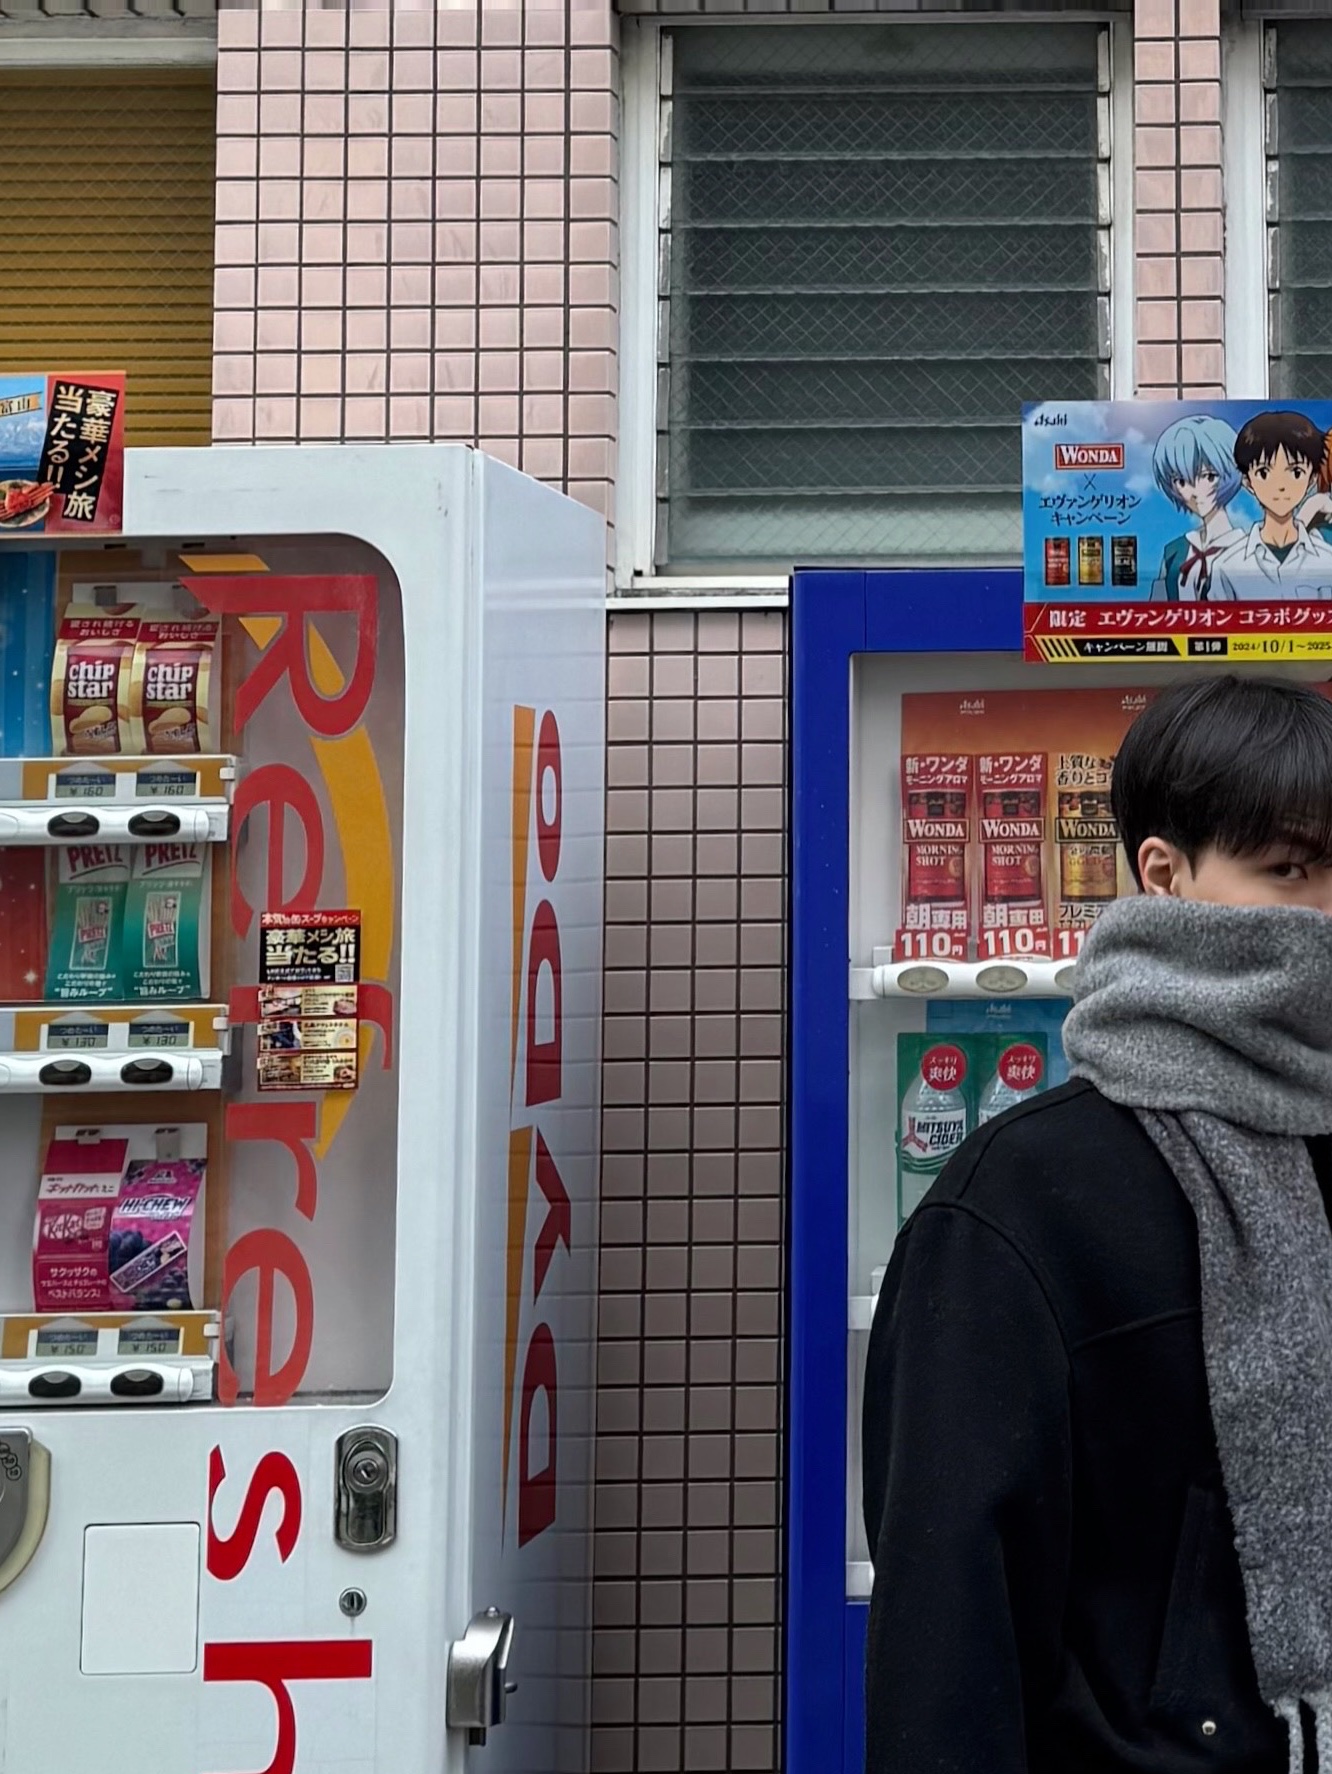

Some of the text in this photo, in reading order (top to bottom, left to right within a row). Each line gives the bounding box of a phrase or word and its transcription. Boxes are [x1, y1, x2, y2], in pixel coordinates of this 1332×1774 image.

[1033, 413, 1068, 427] Asahi
[64, 389, 118, 520] 豪華メシ旅
[1059, 445, 1119, 464] WONDA
[1038, 493, 1142, 510] エヴァンゲリオン
[1050, 511, 1131, 527] キャンペーン
[1049, 609, 1087, 628] 限定
[1097, 608, 1233, 627] エヴァンゲリオン
[69, 661, 115, 680] chip
[147, 663, 194, 682] chip
[67, 679, 114, 699] star
[146, 681, 192, 701] star
[905, 774, 968, 785] モーニングアロマ
[979, 774, 1043, 785] モーニングアロマ
[907, 819, 966, 839] WONDA
[981, 819, 1040, 839] WONDA
[1060, 818, 1117, 838] WONDA
[915, 855, 946, 867] SHOT
[991, 855, 1022, 867] SHOT
[905, 902, 968, 930] 朝専用
[982, 901, 1045, 929] 朝専用
[265, 927, 357, 945] 豪華メシ旅
[900, 931, 963, 958] 110円
[983, 927, 1047, 960] 110円
[928, 1065, 957, 1082] 爽快
[1006, 1064, 1036, 1081] 爽快
[916, 1119, 964, 1134] MITSUYA
[928, 1132, 964, 1146] CIDER
